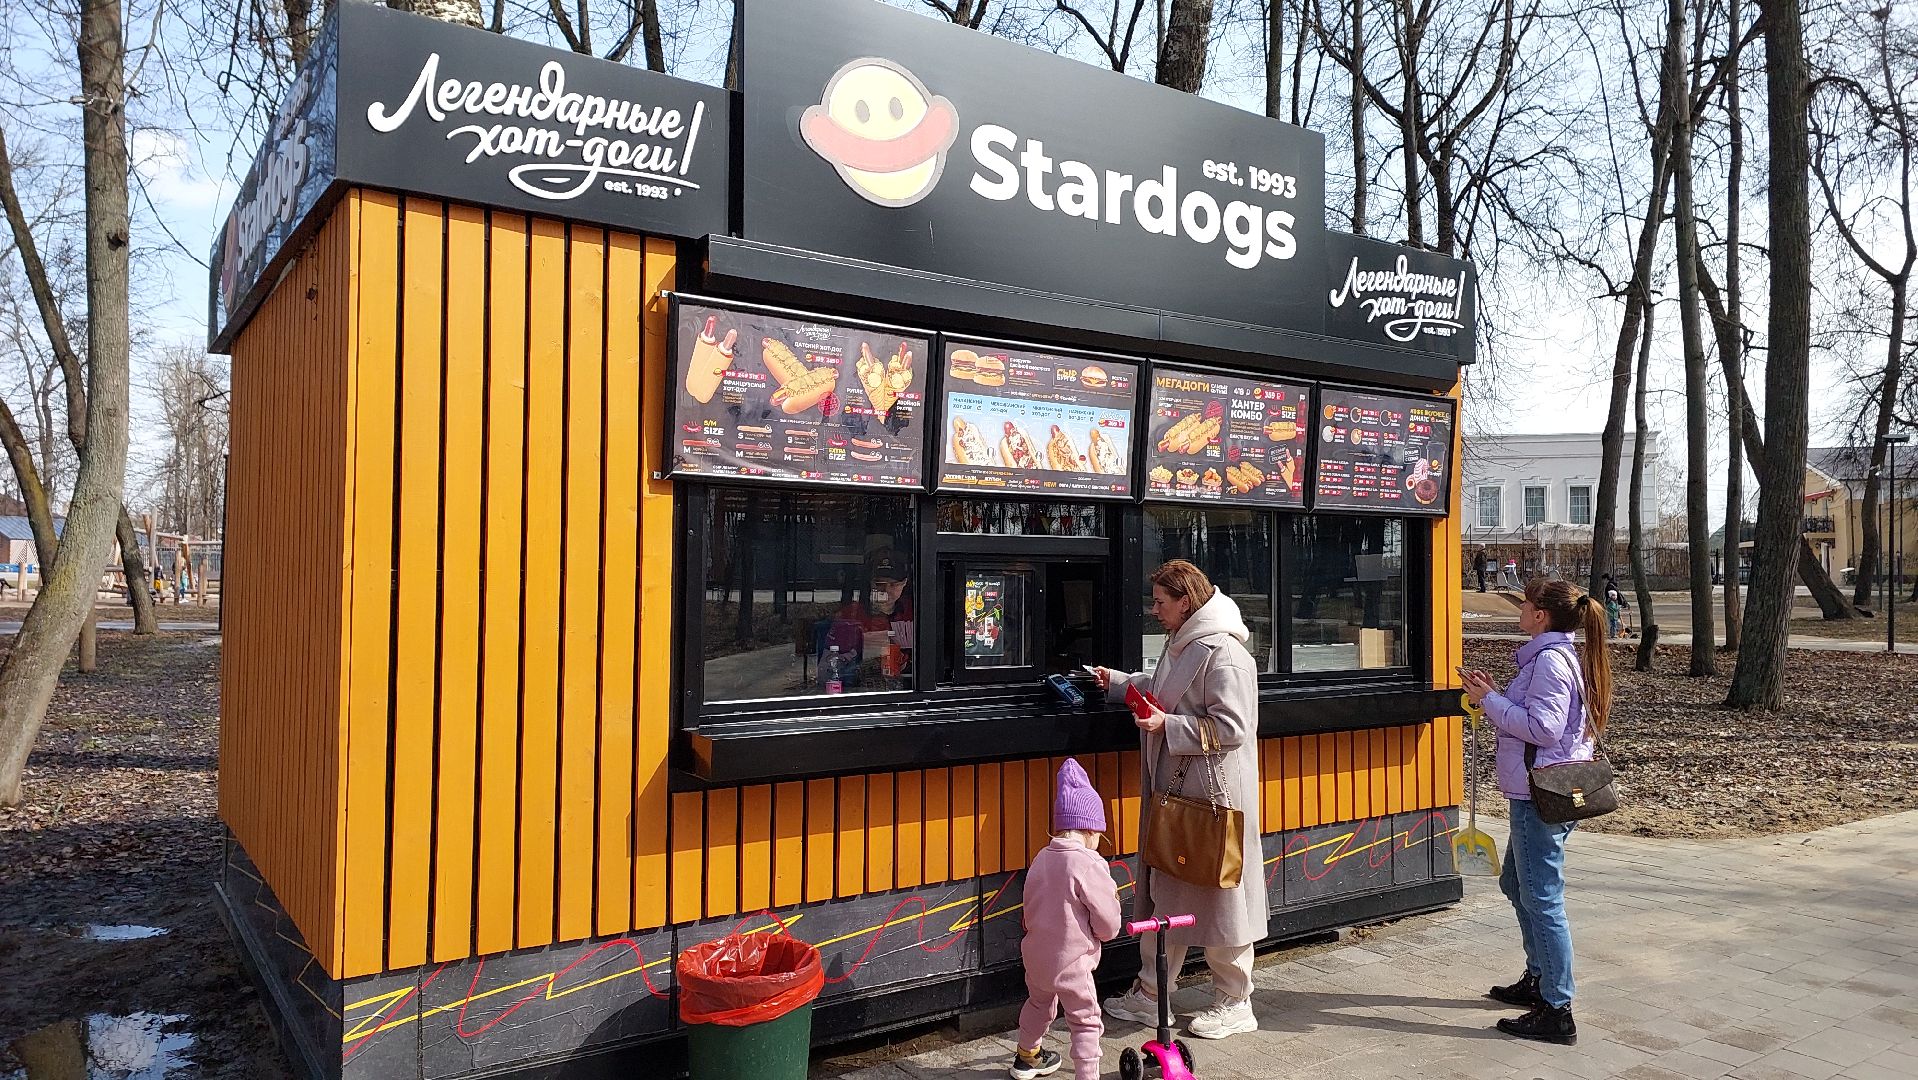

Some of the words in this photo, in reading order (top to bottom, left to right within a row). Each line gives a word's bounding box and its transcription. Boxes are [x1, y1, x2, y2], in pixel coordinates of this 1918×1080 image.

[367, 53, 684, 139] Легендарные
[1202, 158, 1244, 187] est.
[1248, 165, 1297, 199] 1993
[605, 179, 632, 192] est.
[635, 182, 668, 199] 1993
[969, 123, 1297, 270] Stardogs
[1330, 255, 1457, 307] Легендарные
[1422, 327, 1436, 336] est.
[1156, 376, 1210, 392] МЕГАДОГИ
[1230, 398, 1266, 411] ХАНТЕР
[1230, 409, 1263, 421] КОМБО
[1281, 411, 1297, 419] SIZE
[703, 426, 725, 436] SIZE
[683, 446, 691, 454] M
[735, 450, 744, 458] M
[828, 453, 846, 461] SIZE
